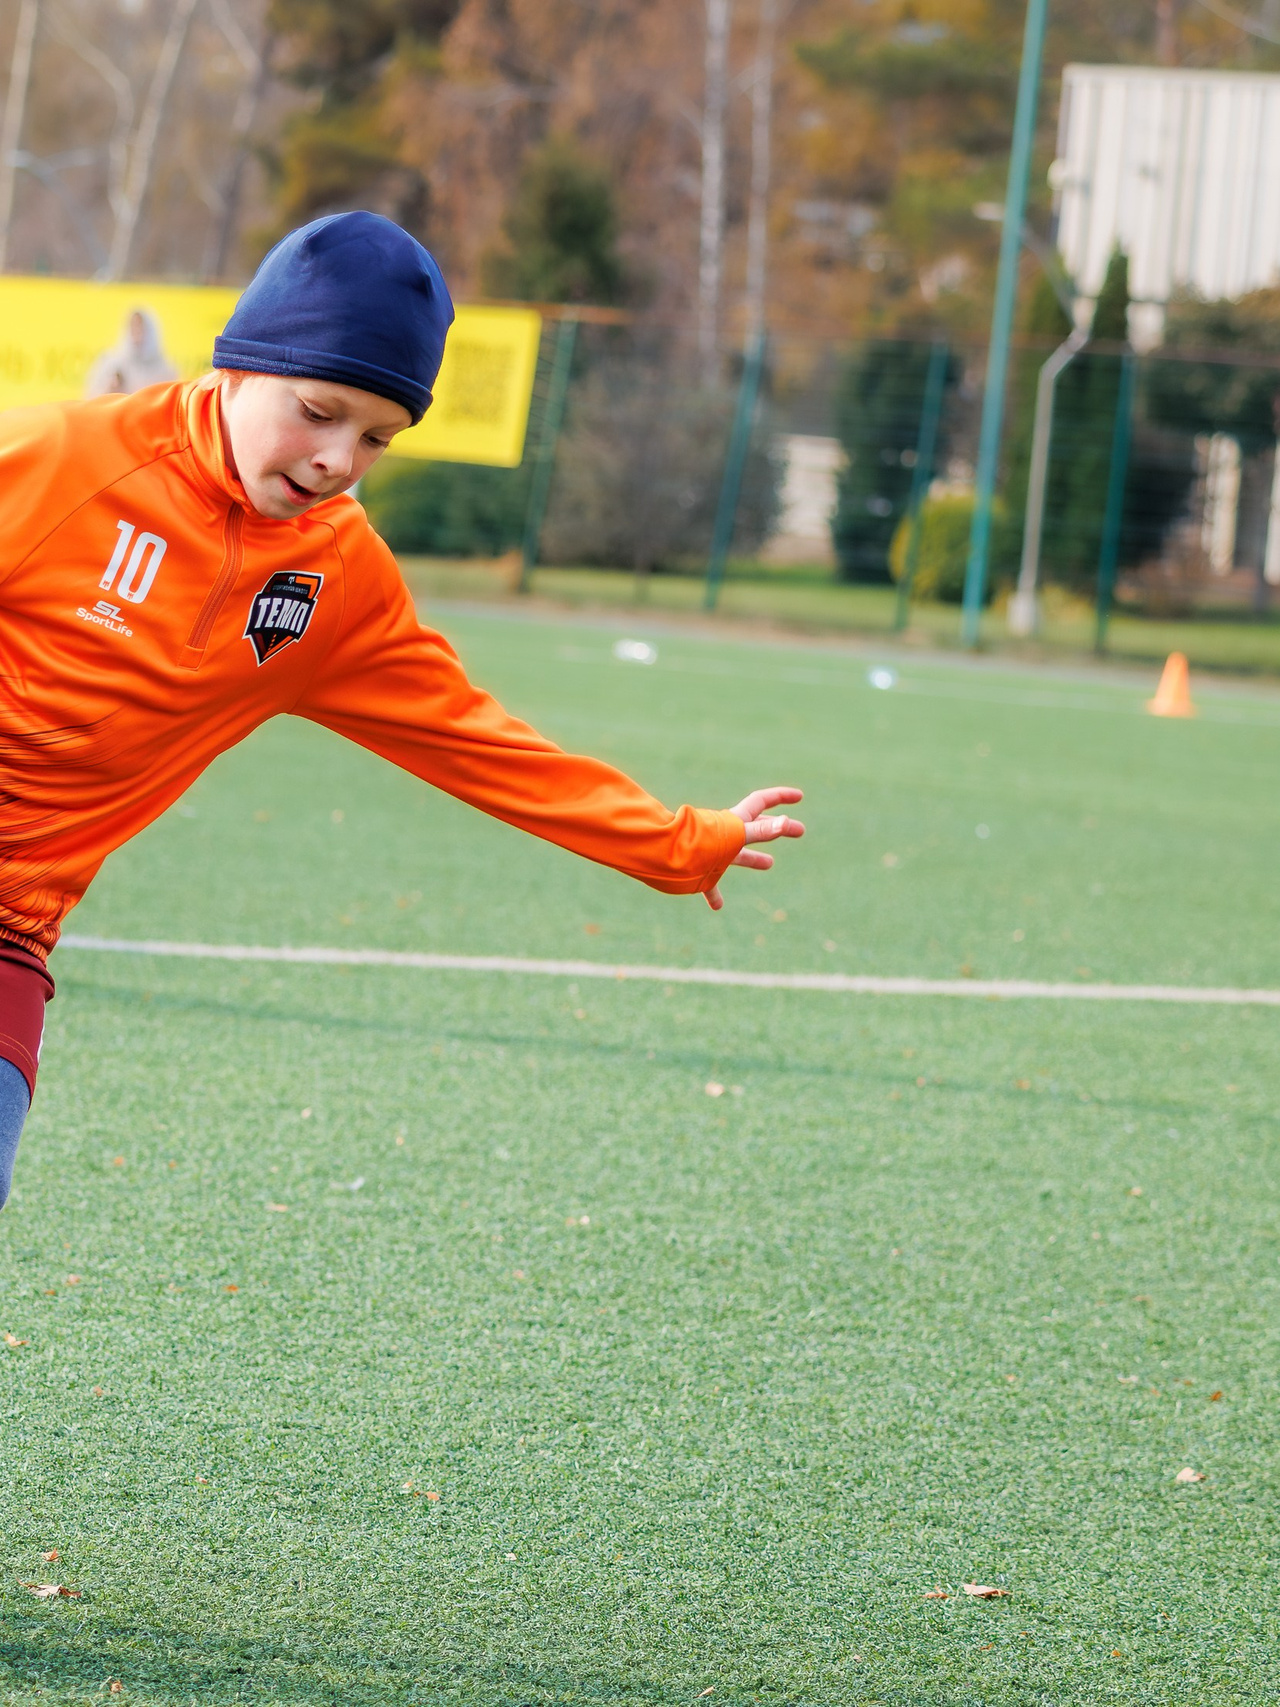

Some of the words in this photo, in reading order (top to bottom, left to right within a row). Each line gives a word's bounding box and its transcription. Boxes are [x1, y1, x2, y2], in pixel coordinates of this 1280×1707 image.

[98, 519, 168, 604] 10
[75, 607, 133, 637] SportLife
[254, 597, 310, 634] ТЕМП
